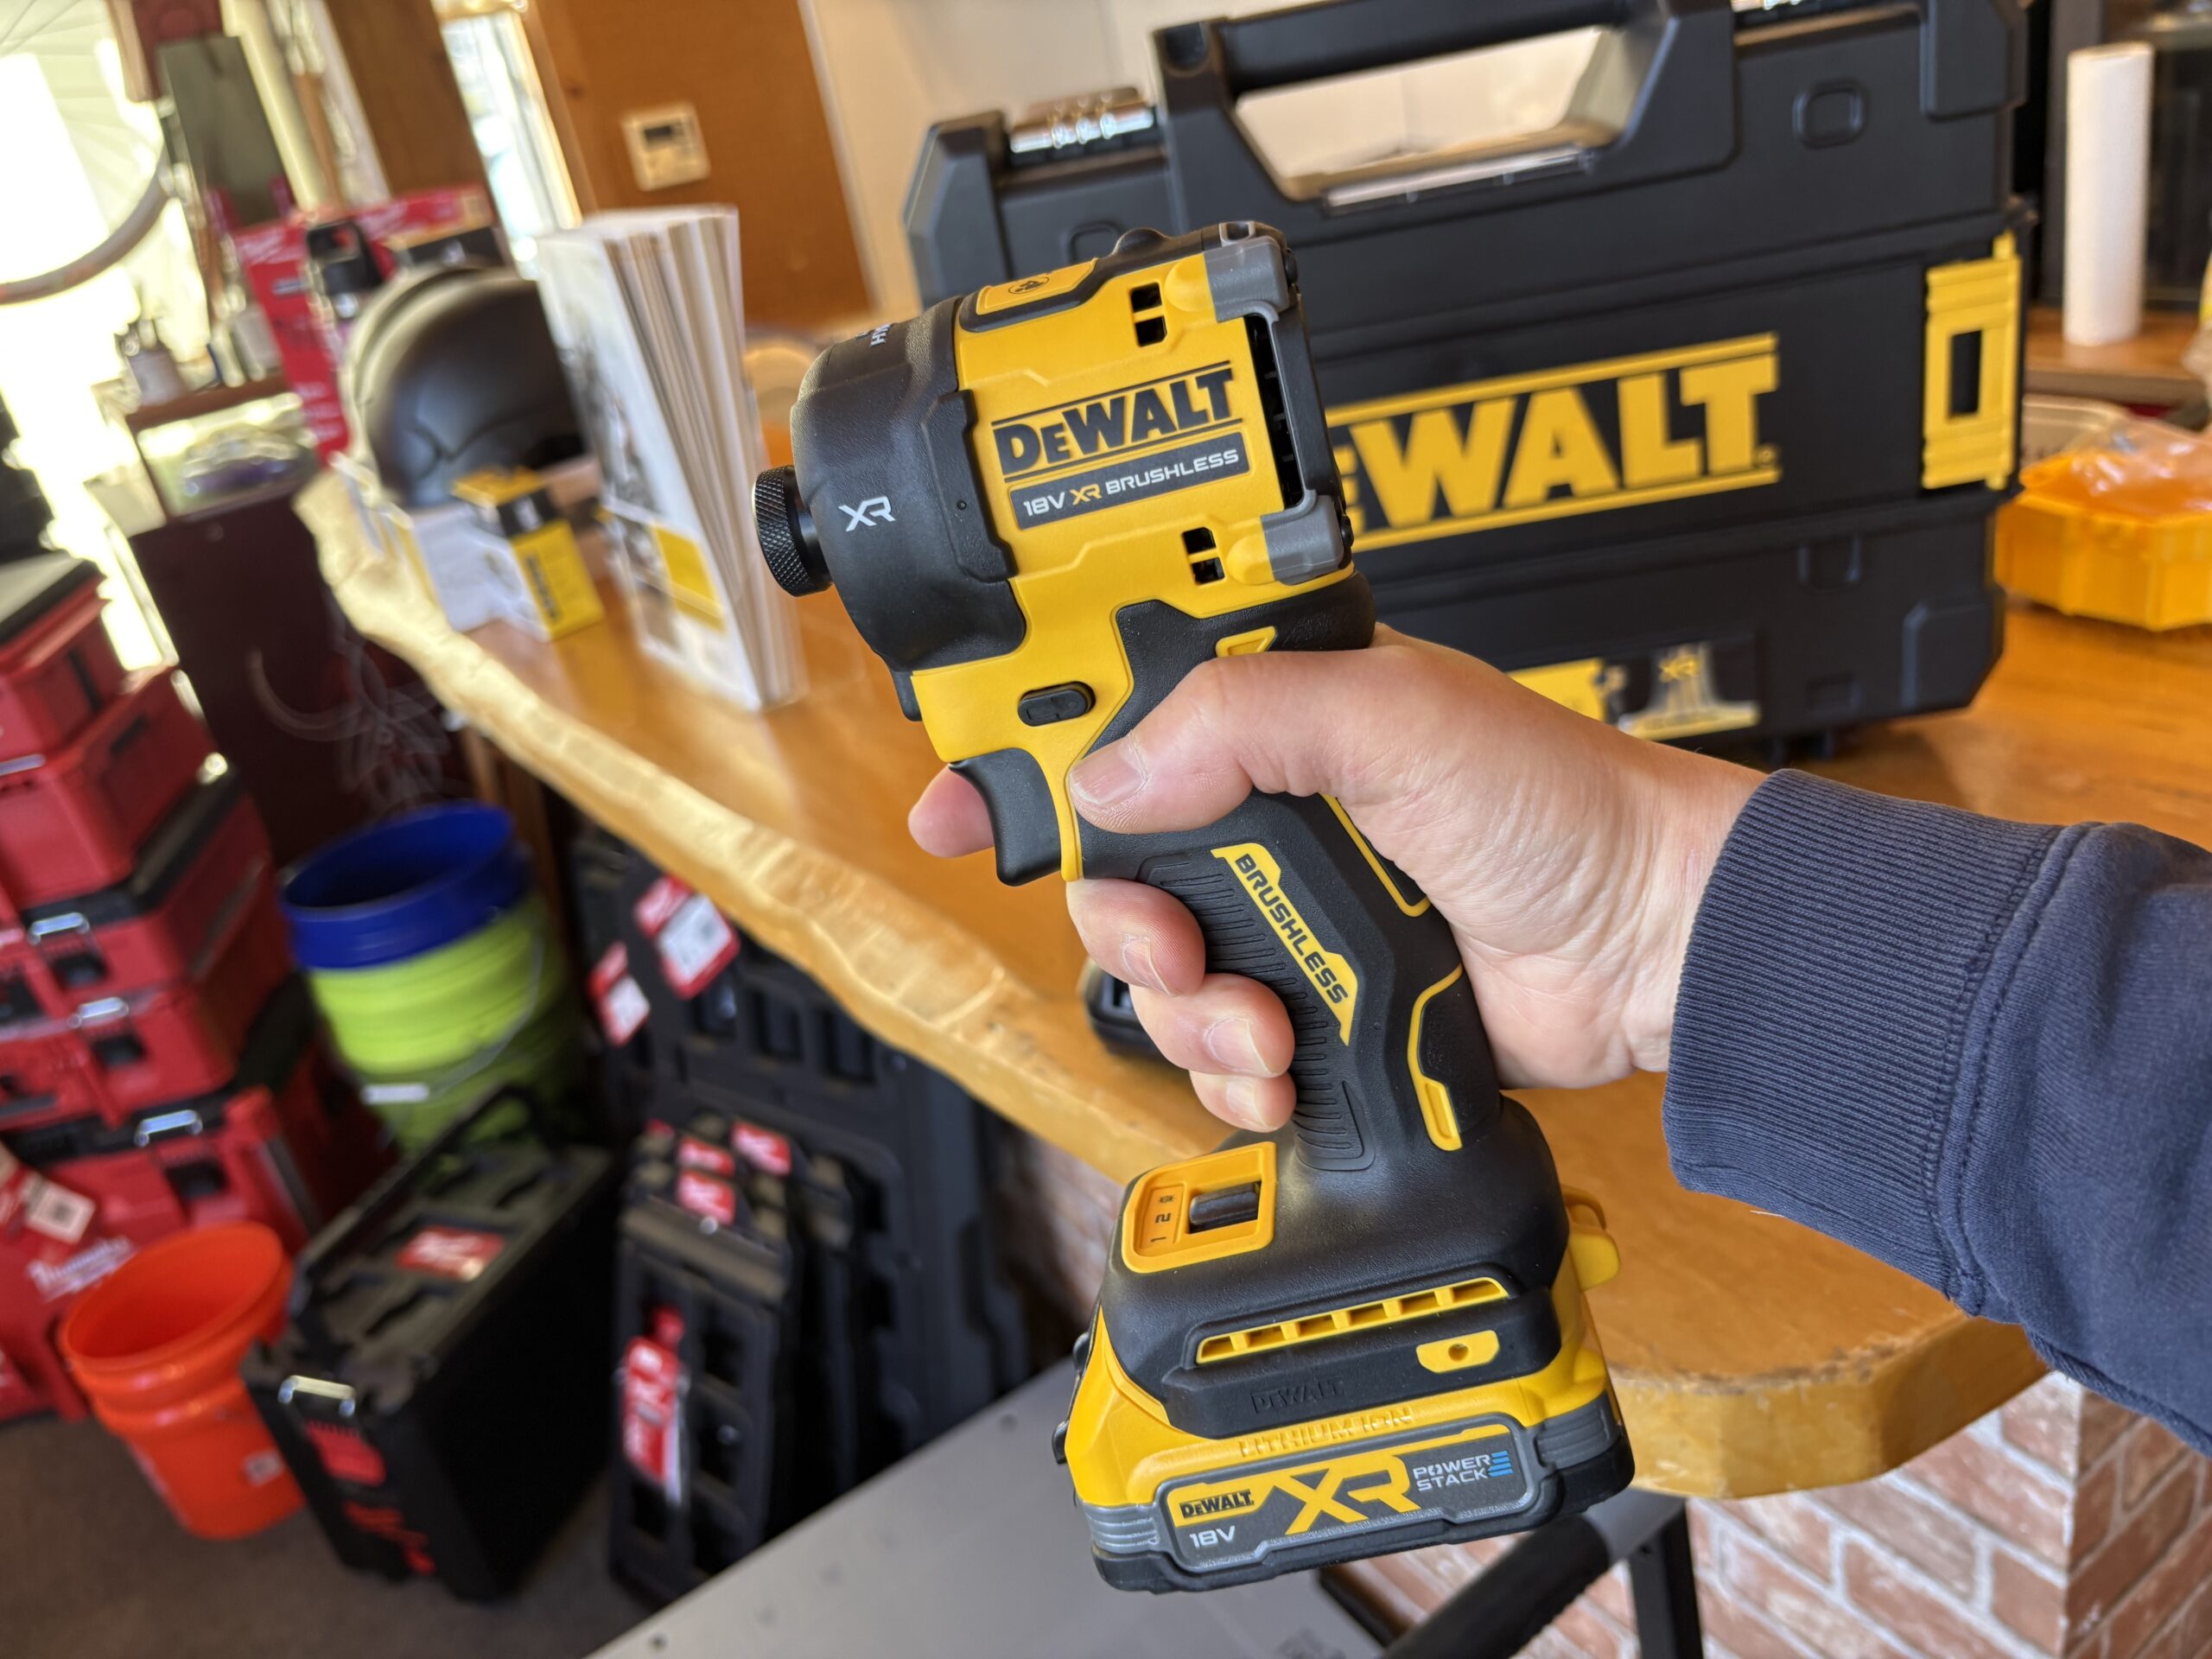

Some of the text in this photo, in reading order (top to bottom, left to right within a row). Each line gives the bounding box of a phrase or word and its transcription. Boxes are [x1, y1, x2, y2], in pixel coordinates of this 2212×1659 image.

[993, 367, 1234, 476] DEWALT
[1333, 353, 1778, 533] WALT
[1023, 448, 1240, 518] 18V XR BRUSHLESS
[838, 496, 897, 532] XR
[1234, 852, 1349, 1005] BRUSHLESS
[1250, 1378, 1339, 1415] DEWALT
[1238, 1415, 1357, 1458] LITHIUM
[1413, 1454, 1491, 1479] POWER
[1416, 1467, 1489, 1492] STACK
[1179, 1489, 1253, 1519] DEWALT
[1275, 1455, 1422, 1535] XR
[1189, 1525, 1236, 1549] 18V
